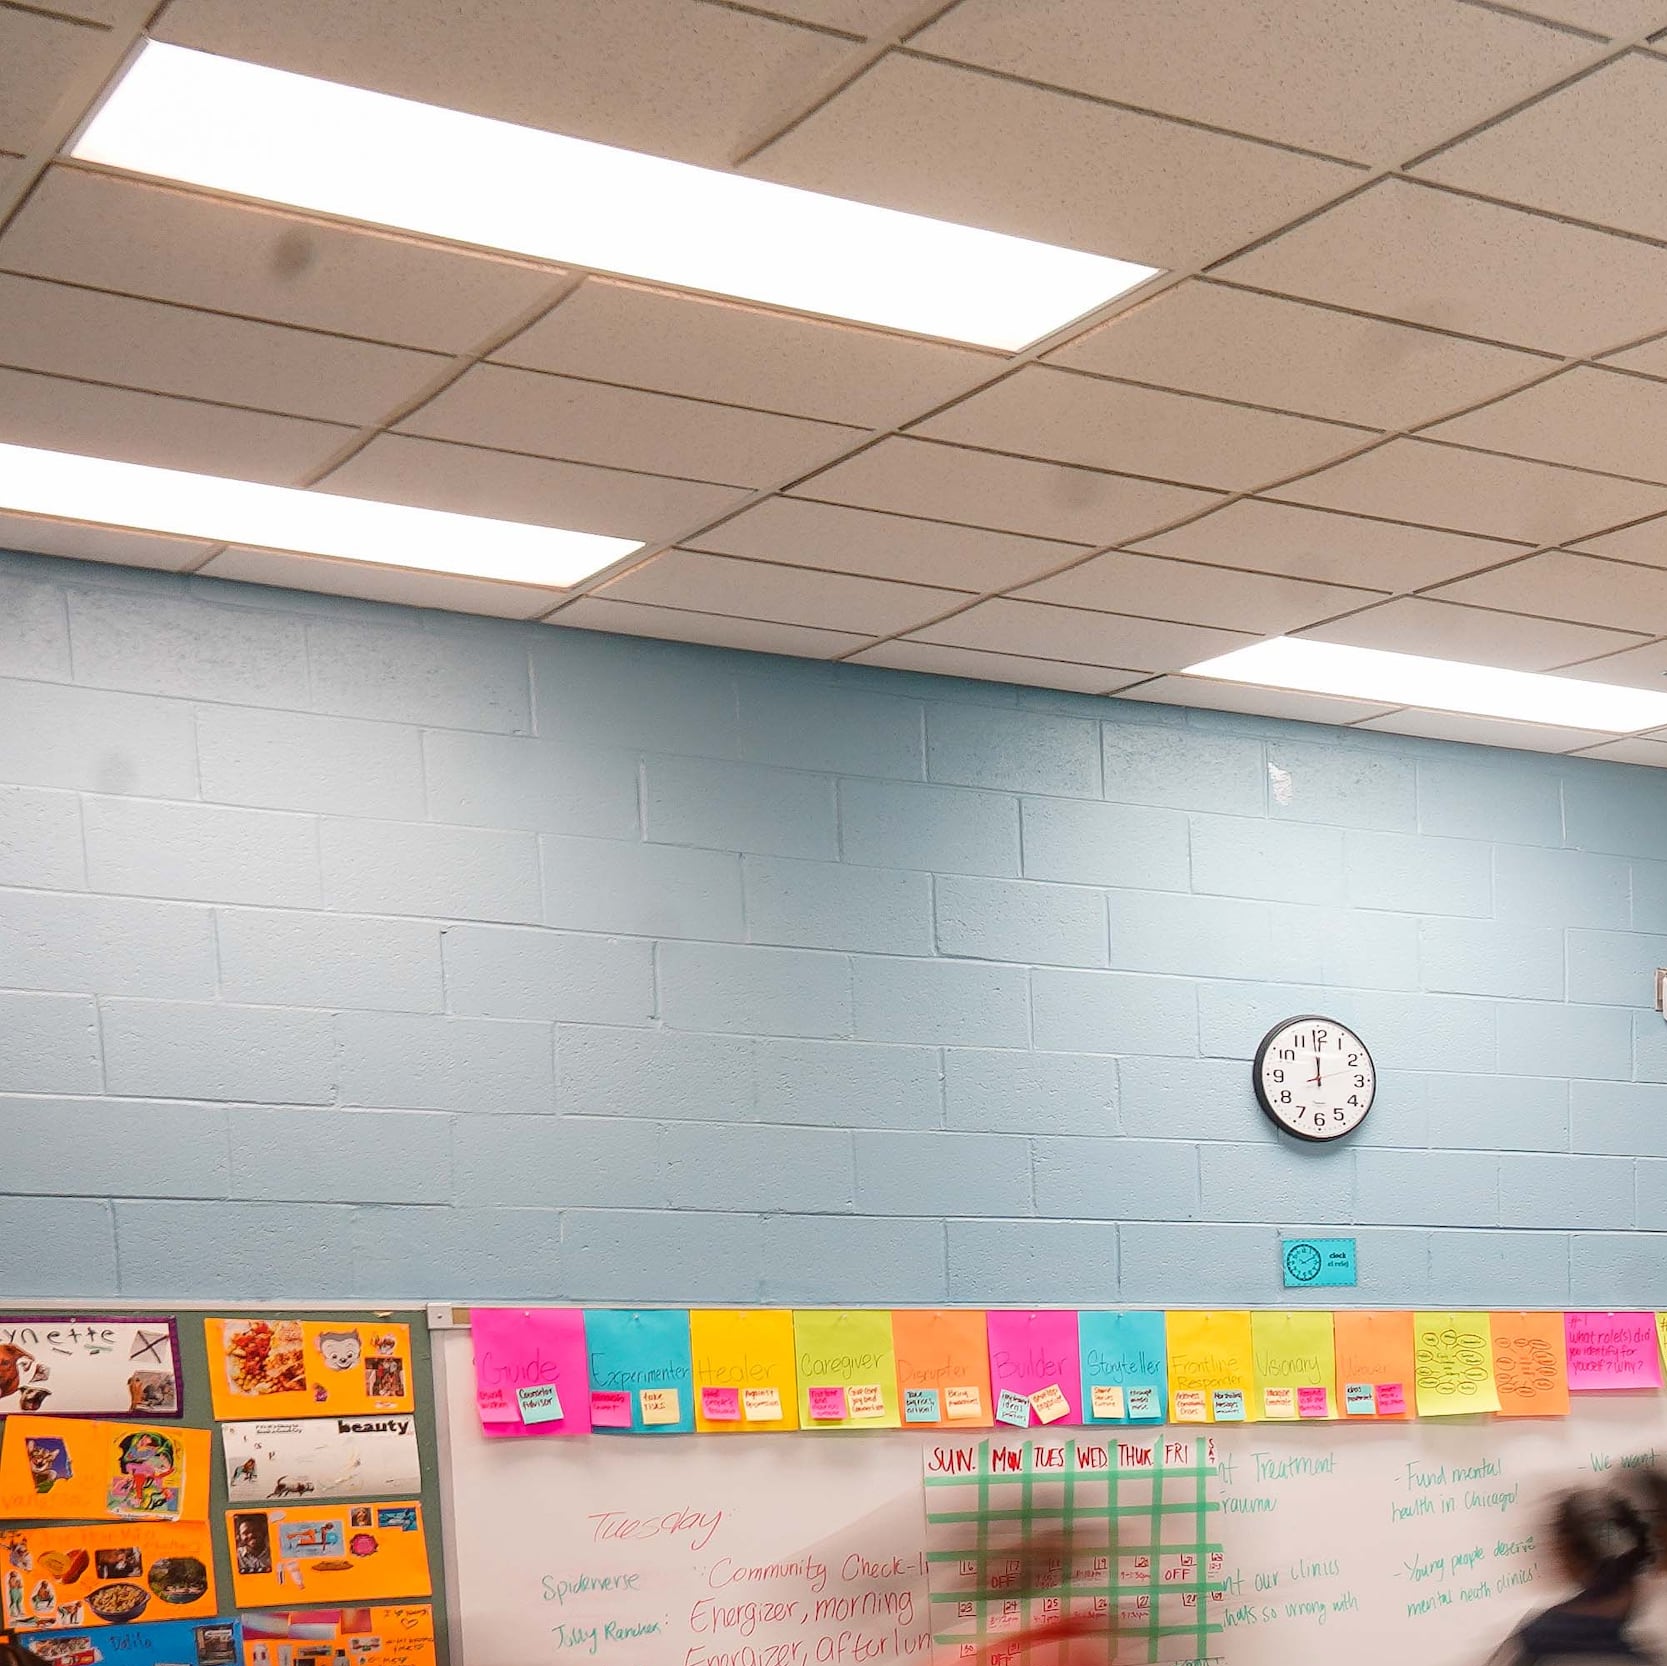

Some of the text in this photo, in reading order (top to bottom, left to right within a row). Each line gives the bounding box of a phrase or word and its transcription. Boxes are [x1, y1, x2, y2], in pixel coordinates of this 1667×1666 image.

[1294, 1034, 1305, 1048] 11
[1337, 1037, 1343, 1051] 1
[1347, 1053, 1358, 1067] 2
[1273, 1069, 1284, 1083] 9
[1353, 1074, 1365, 1088] 3
[1280, 1089, 1292, 1104] 8
[1346, 1094, 1359, 1107] 4
[1296, 1105, 1306, 1119] 7
[1314, 1112, 1326, 1127] 6
[1333, 1107, 1345, 1121] 5
[0, 1326, 115, 1344] ynette
[1598, 1328, 1632, 1344] role(s)
[1634, 1327, 1651, 1343] did
[482, 1348, 560, 1385] Guide
[591, 1352, 689, 1390] Experimenter
[699, 1352, 776, 1384] Healer
[801, 1352, 884, 1379] Caregiver
[898, 1354, 968, 1384] Disrupter
[993, 1347, 1068, 1379] Builder
[1087, 1350, 1161, 1383] Storyteller
[1172, 1353, 1240, 1375] Frontline
[1256, 1350, 1322, 1384] Visionary
[1176, 1375, 1243, 1391] Responder
[338, 1419, 409, 1435] beauty
[1034, 1446, 1064, 1468] TUES
[1164, 1442, 1189, 1465] FRI
[1620, 1447, 1661, 1469] want
[1250, 1451, 1337, 1483] Treatment
[1452, 1457, 1504, 1483] mental
[1220, 1490, 1278, 1514] rauma
[1391, 1482, 1519, 1523] health in Chicago!
[588, 1505, 723, 1551] Tuesday
[1451, 1535, 1536, 1576] people deserve
[708, 1554, 827, 1593] Community
[1164, 1568, 1191, 1581] OFF
[1254, 1560, 1340, 1592] our clinics
[541, 1573, 640, 1605] Spiderverse
[690, 1590, 915, 1637] Energizer, morning
[1262, 1608, 1277, 1623] so
[1333, 1591, 1360, 1613] with
[1407, 1590, 1453, 1618] mental
